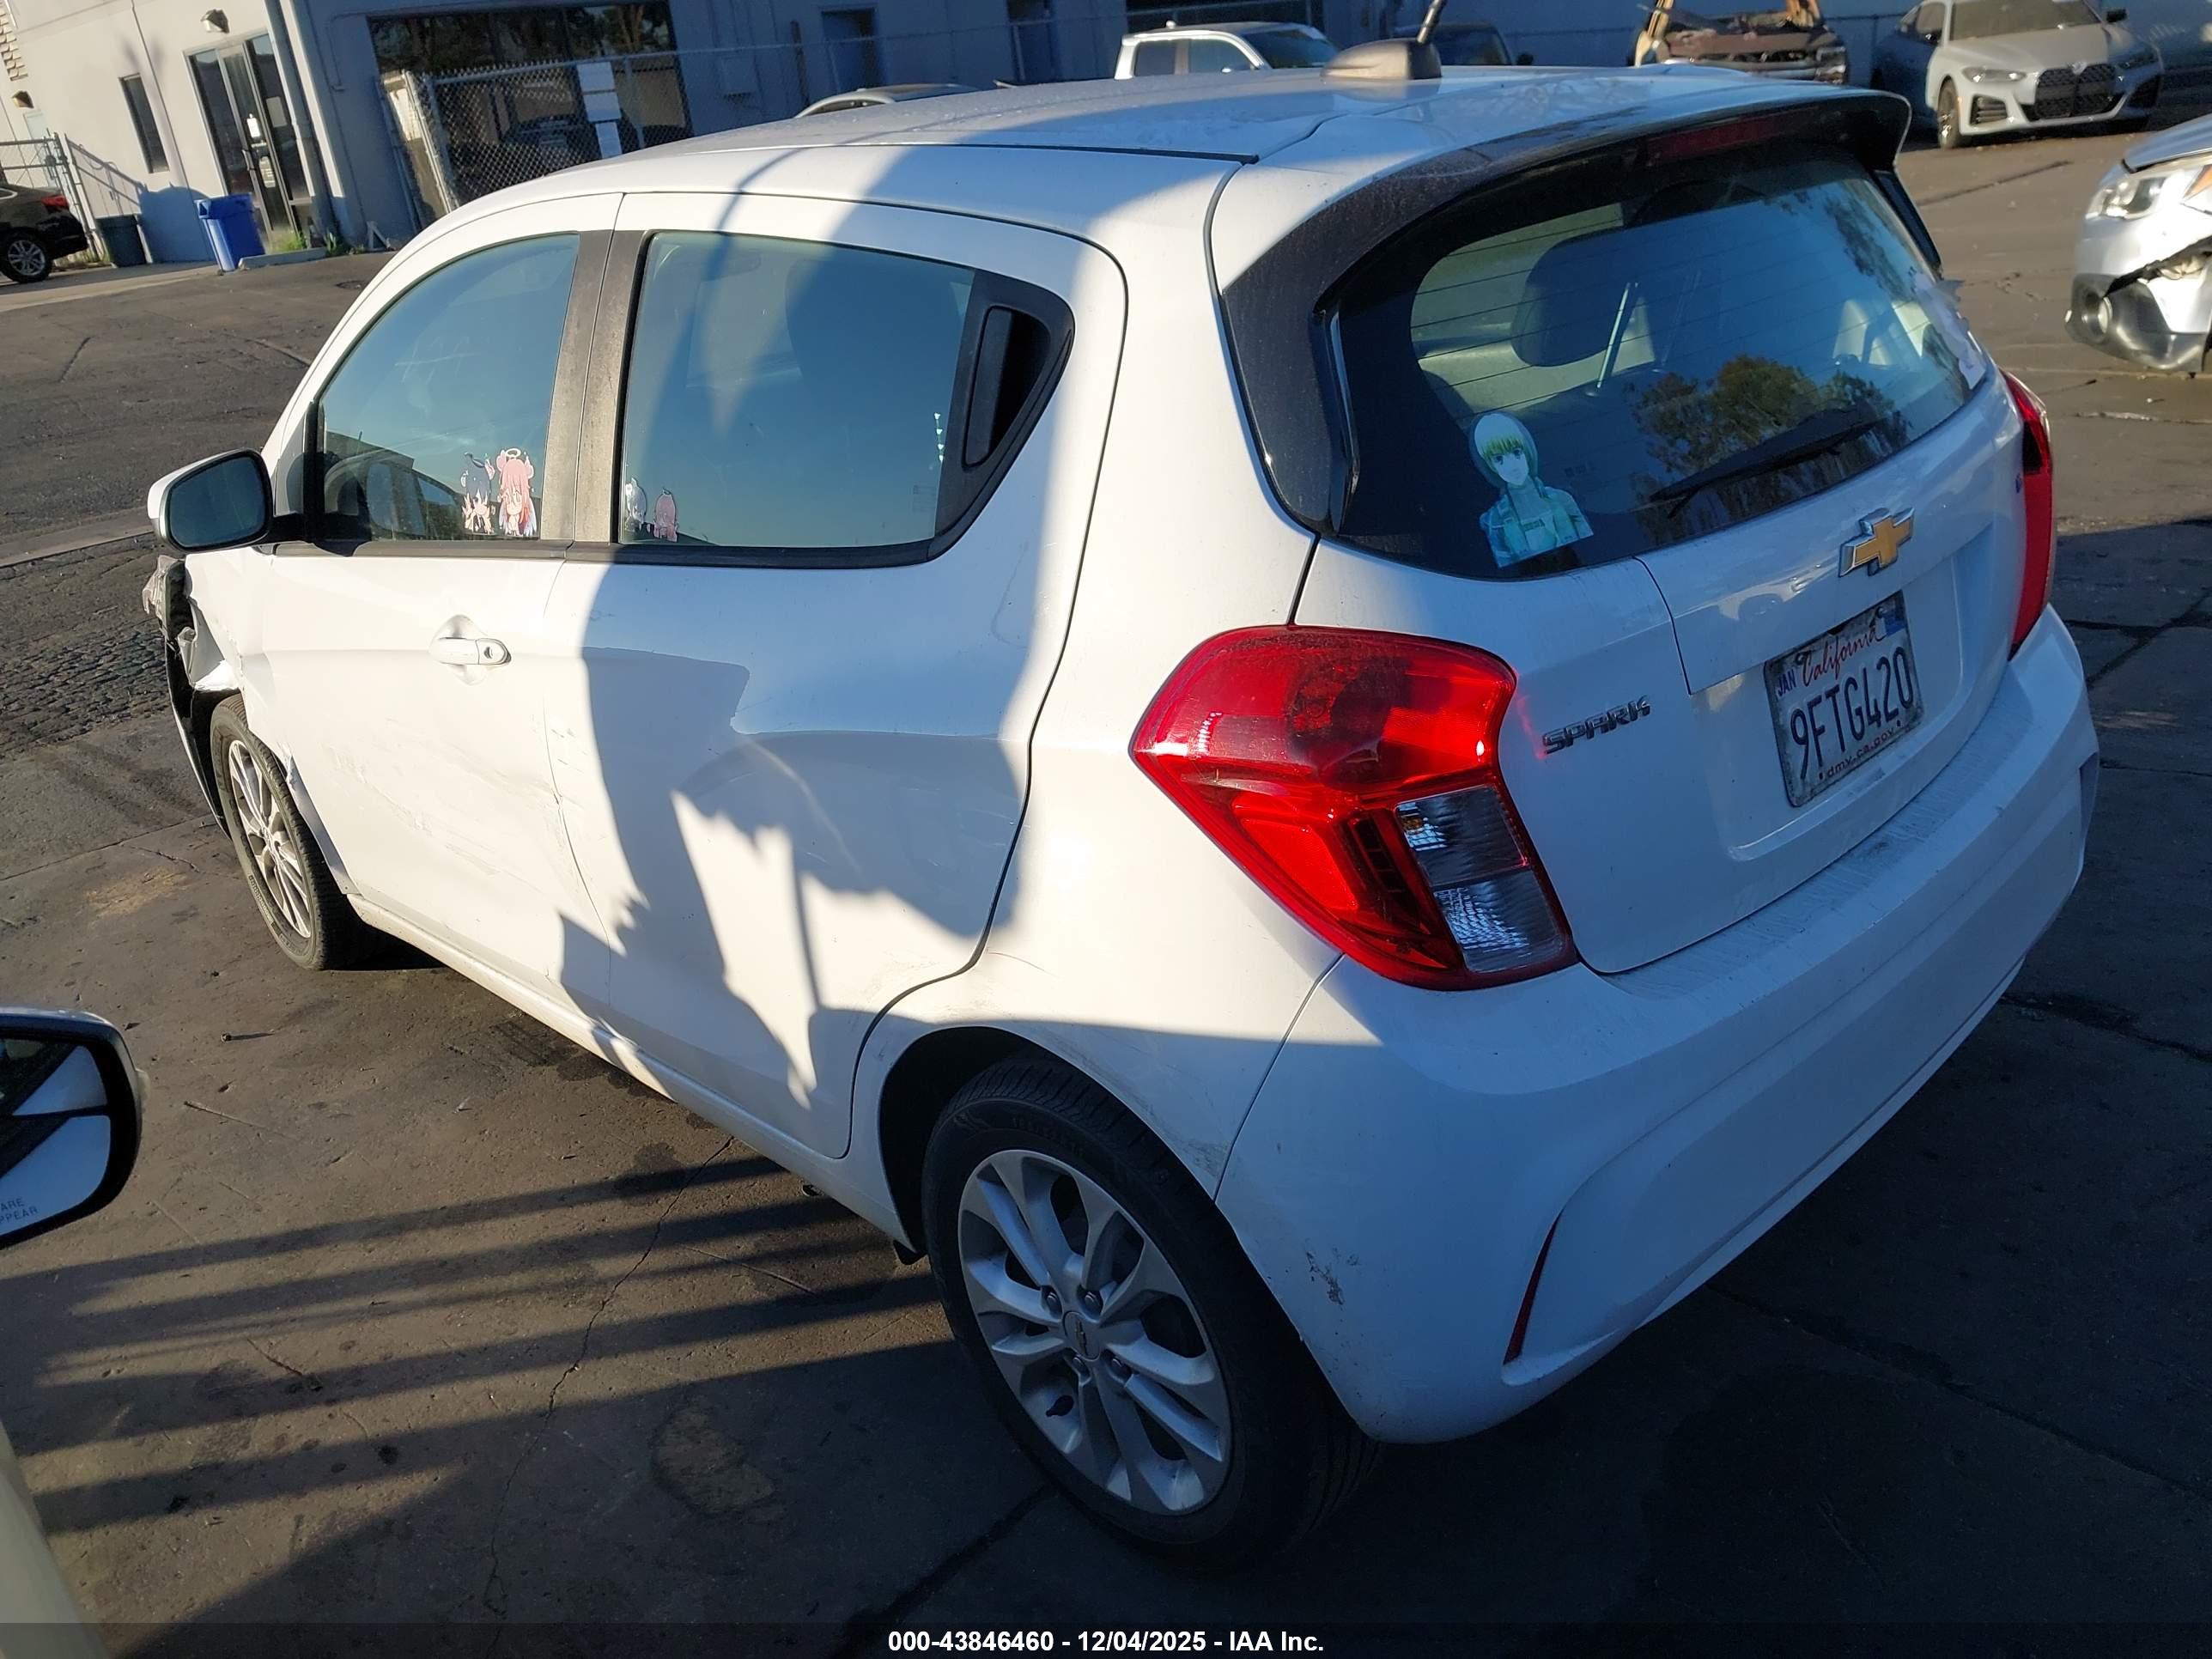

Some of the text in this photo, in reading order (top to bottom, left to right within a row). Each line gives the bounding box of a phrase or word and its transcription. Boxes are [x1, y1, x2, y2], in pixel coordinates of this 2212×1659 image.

[1777, 668, 1796, 696] JAN
[1795, 624, 1888, 687] California
[1542, 695, 1650, 755] SPARK
[1790, 646, 1914, 781] 9FTG420
